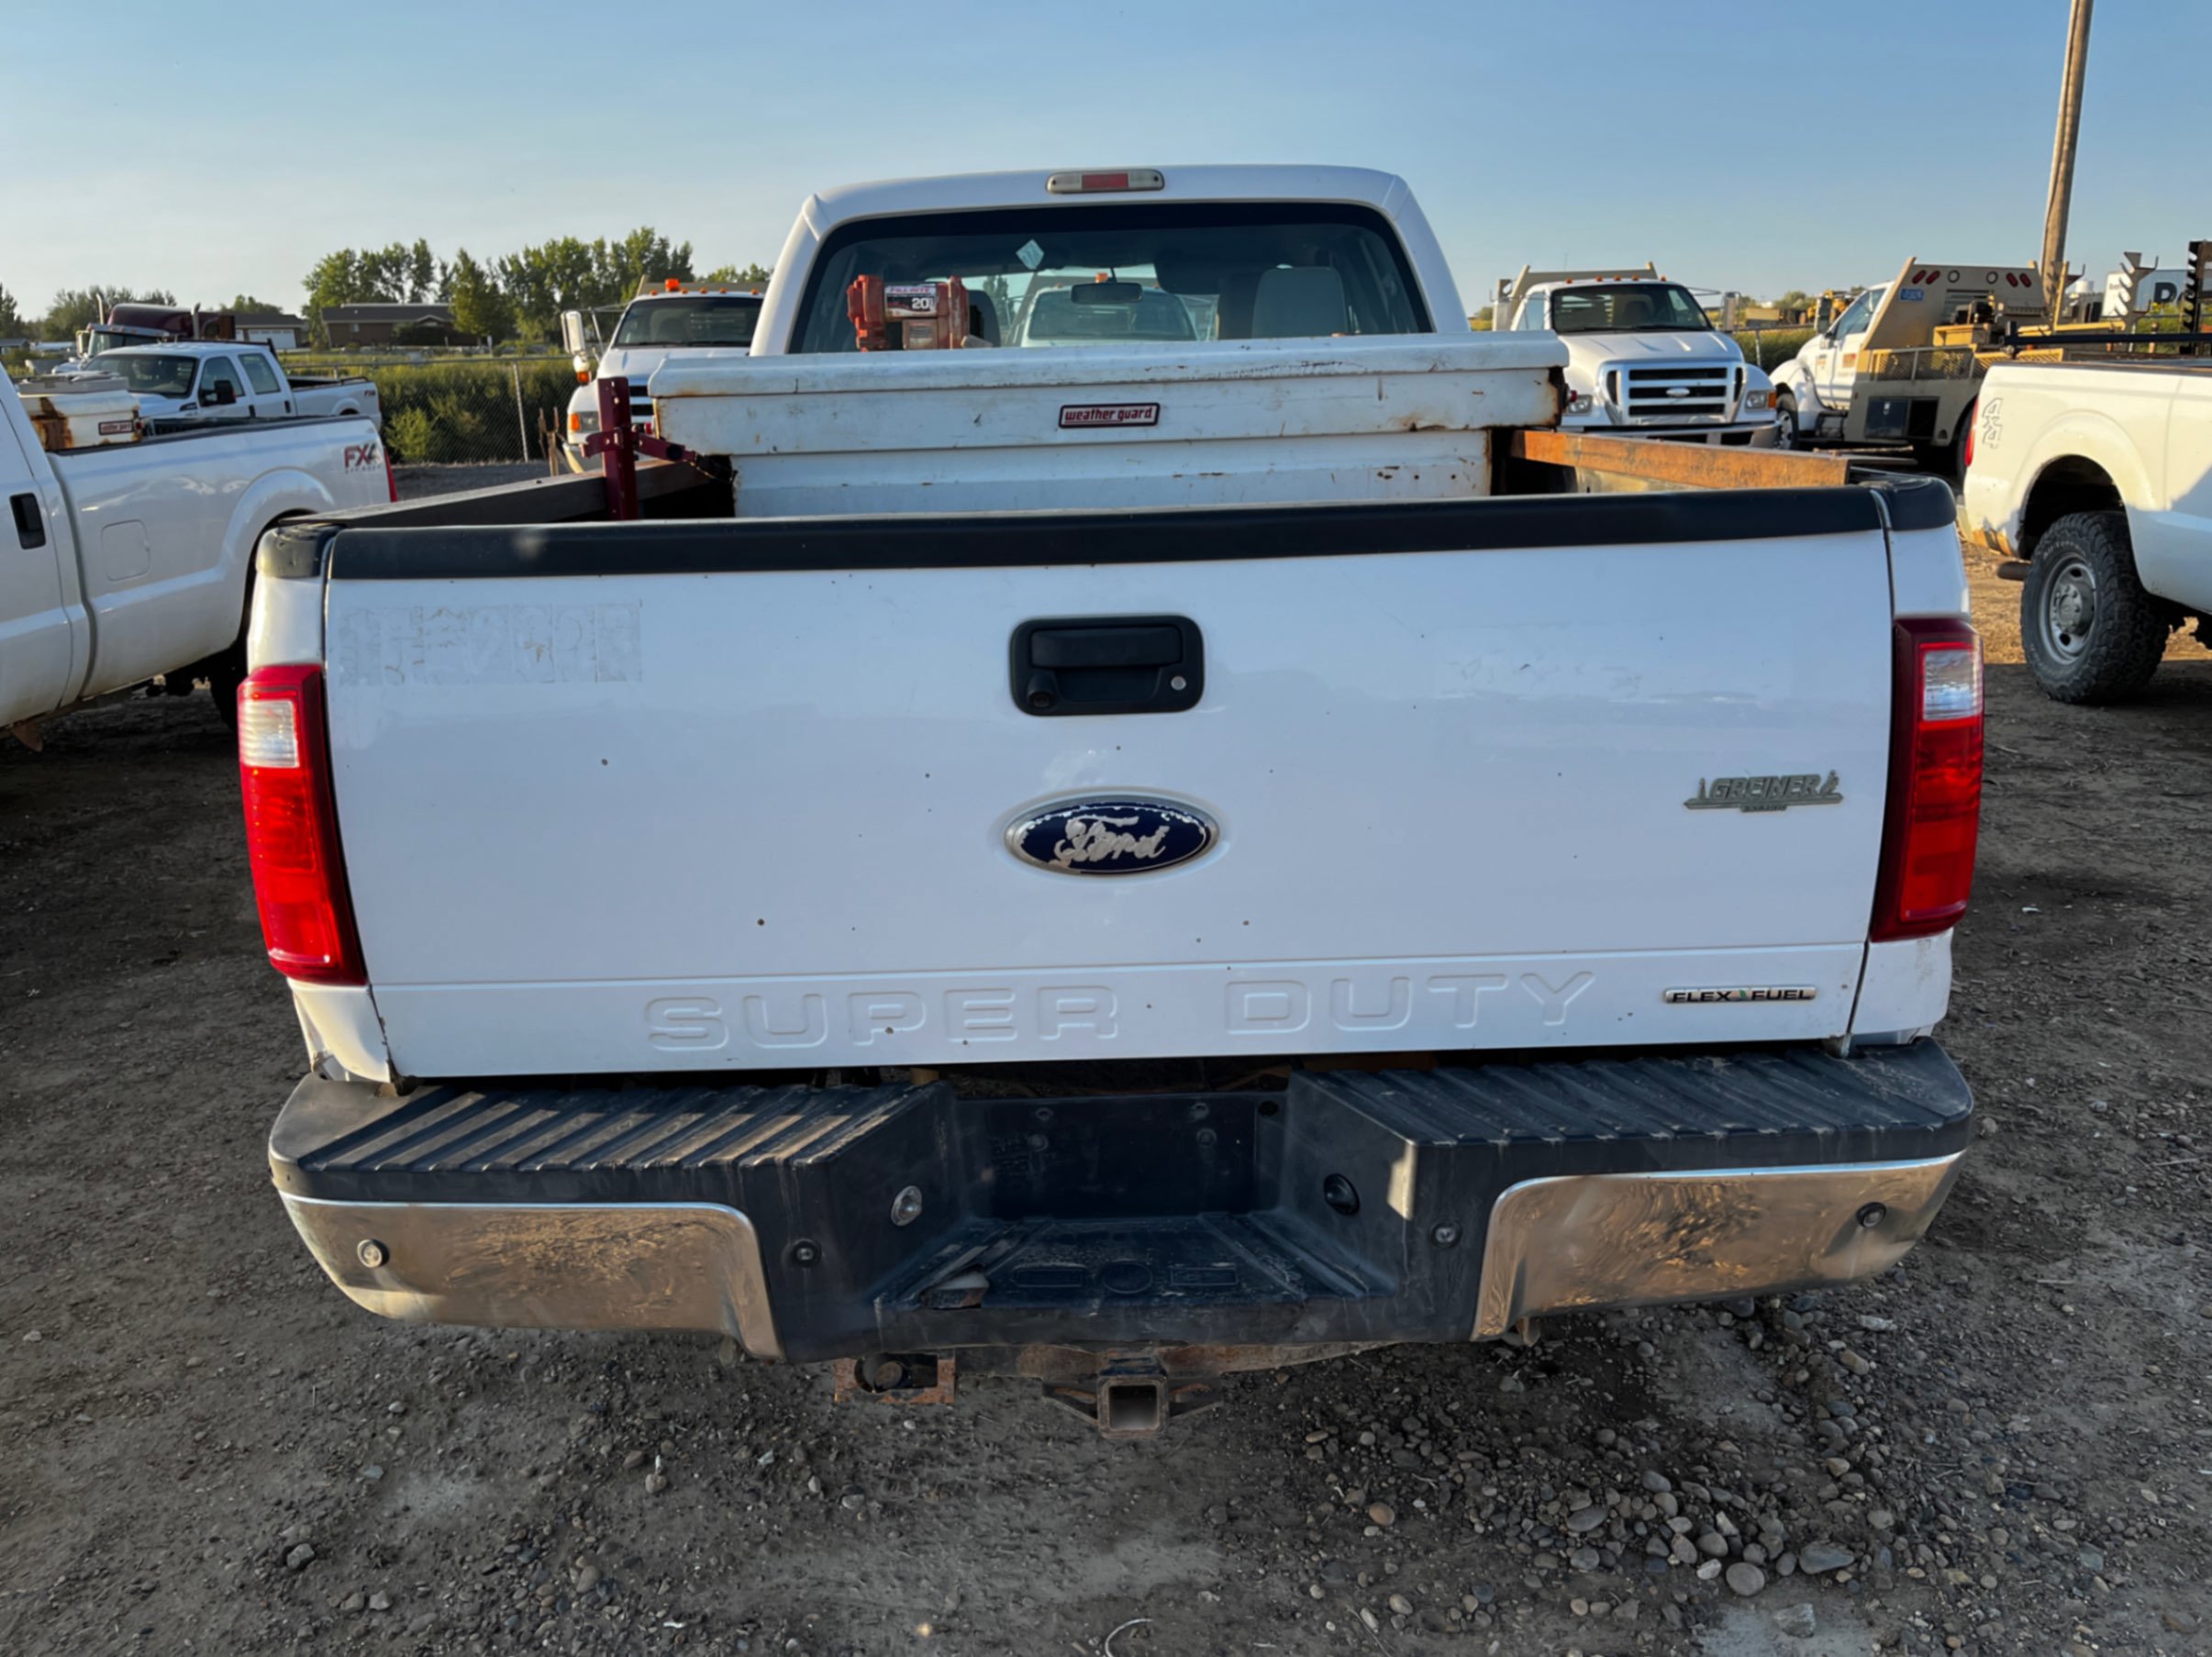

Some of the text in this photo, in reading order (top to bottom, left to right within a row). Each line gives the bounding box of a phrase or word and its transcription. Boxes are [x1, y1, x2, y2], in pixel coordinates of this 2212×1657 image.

[1064, 407, 1153, 422] weather guard
[343, 442, 381, 468] FX4
[1709, 773, 1822, 802] GREINER
[1052, 815, 1171, 863] Ford
[1672, 989, 1812, 1003] FLEX FUEL
[645, 970, 1596, 1051] SUPER DUTY
